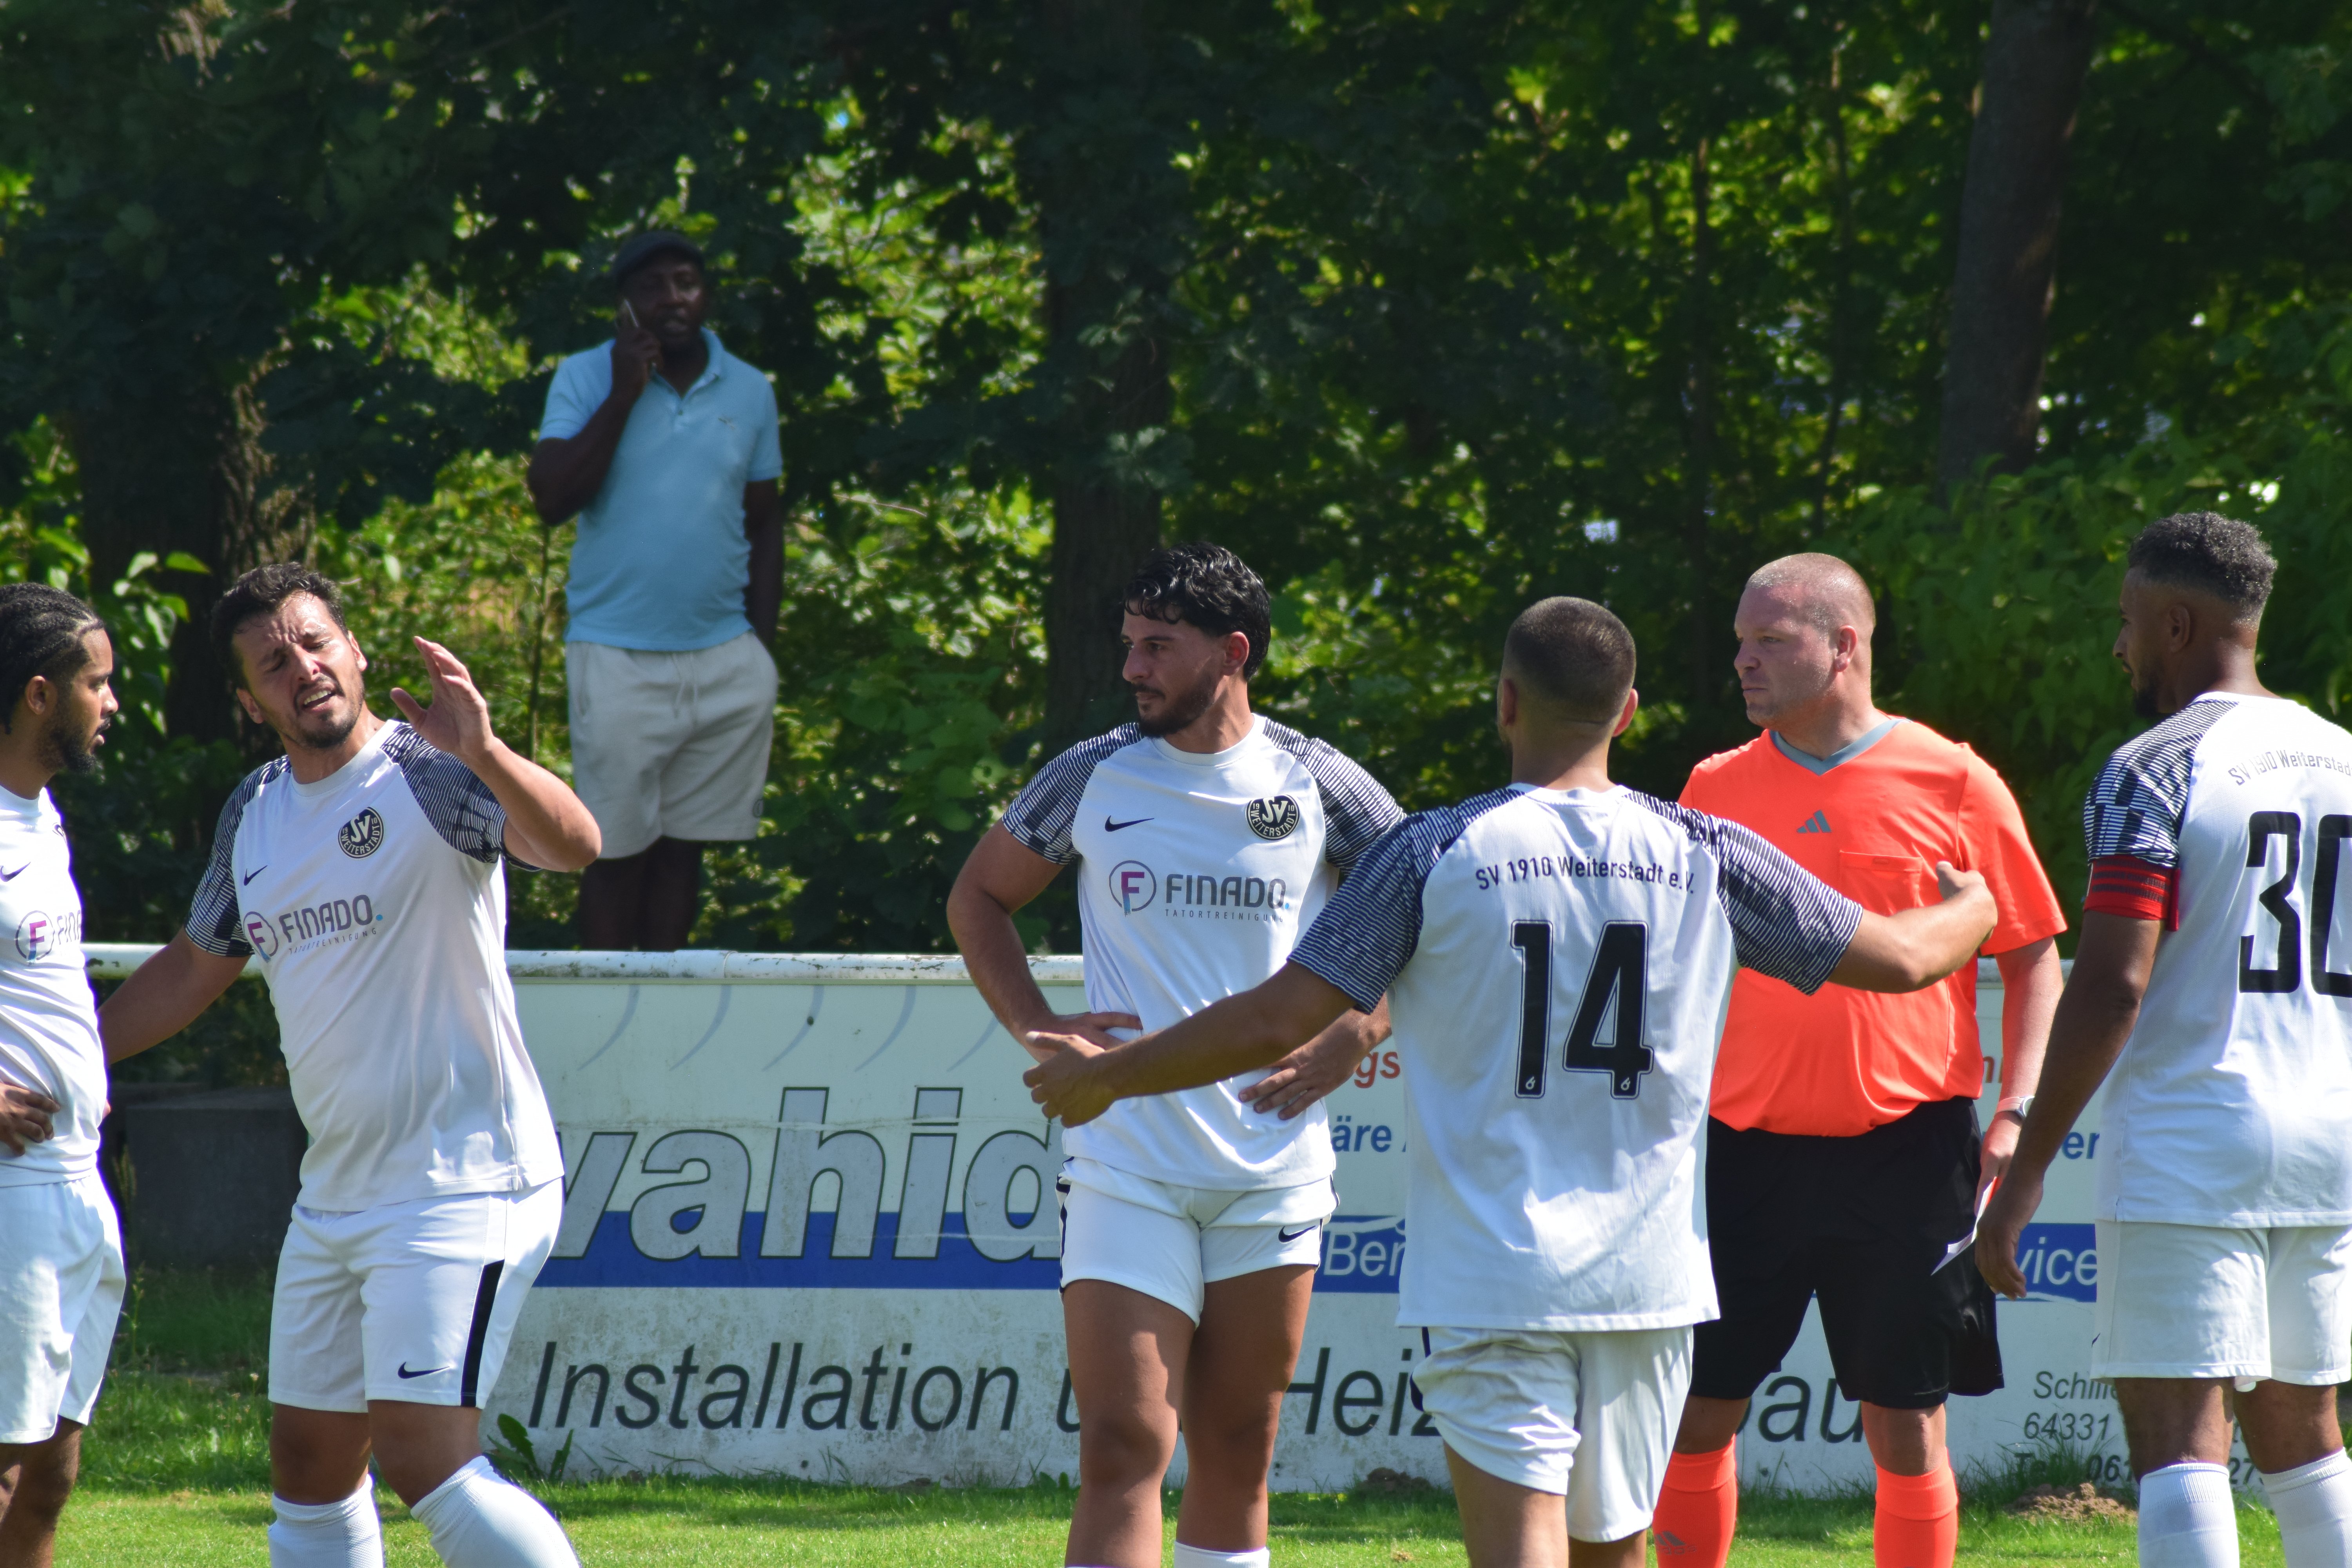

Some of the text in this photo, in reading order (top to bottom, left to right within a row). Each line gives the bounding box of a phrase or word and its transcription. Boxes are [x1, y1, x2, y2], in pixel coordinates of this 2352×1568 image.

[2228, 762, 2251, 786] SV
[2276, 750, 2352, 776] Weiterstad
[1250, 810, 1296, 837] WEITERSTADT
[1262, 797, 1288, 823] SV
[341, 825, 380, 855] WEITERSTADT
[350, 815, 371, 842] SV
[1475, 856, 1694, 894] SV 1910 Weiterstadt e.V.
[2239, 811, 2352, 998] 30
[1510, 919, 1655, 1099] 14
[528, 1341, 1021, 1431] Installation
[2024, 1412, 2110, 1441] 64331
